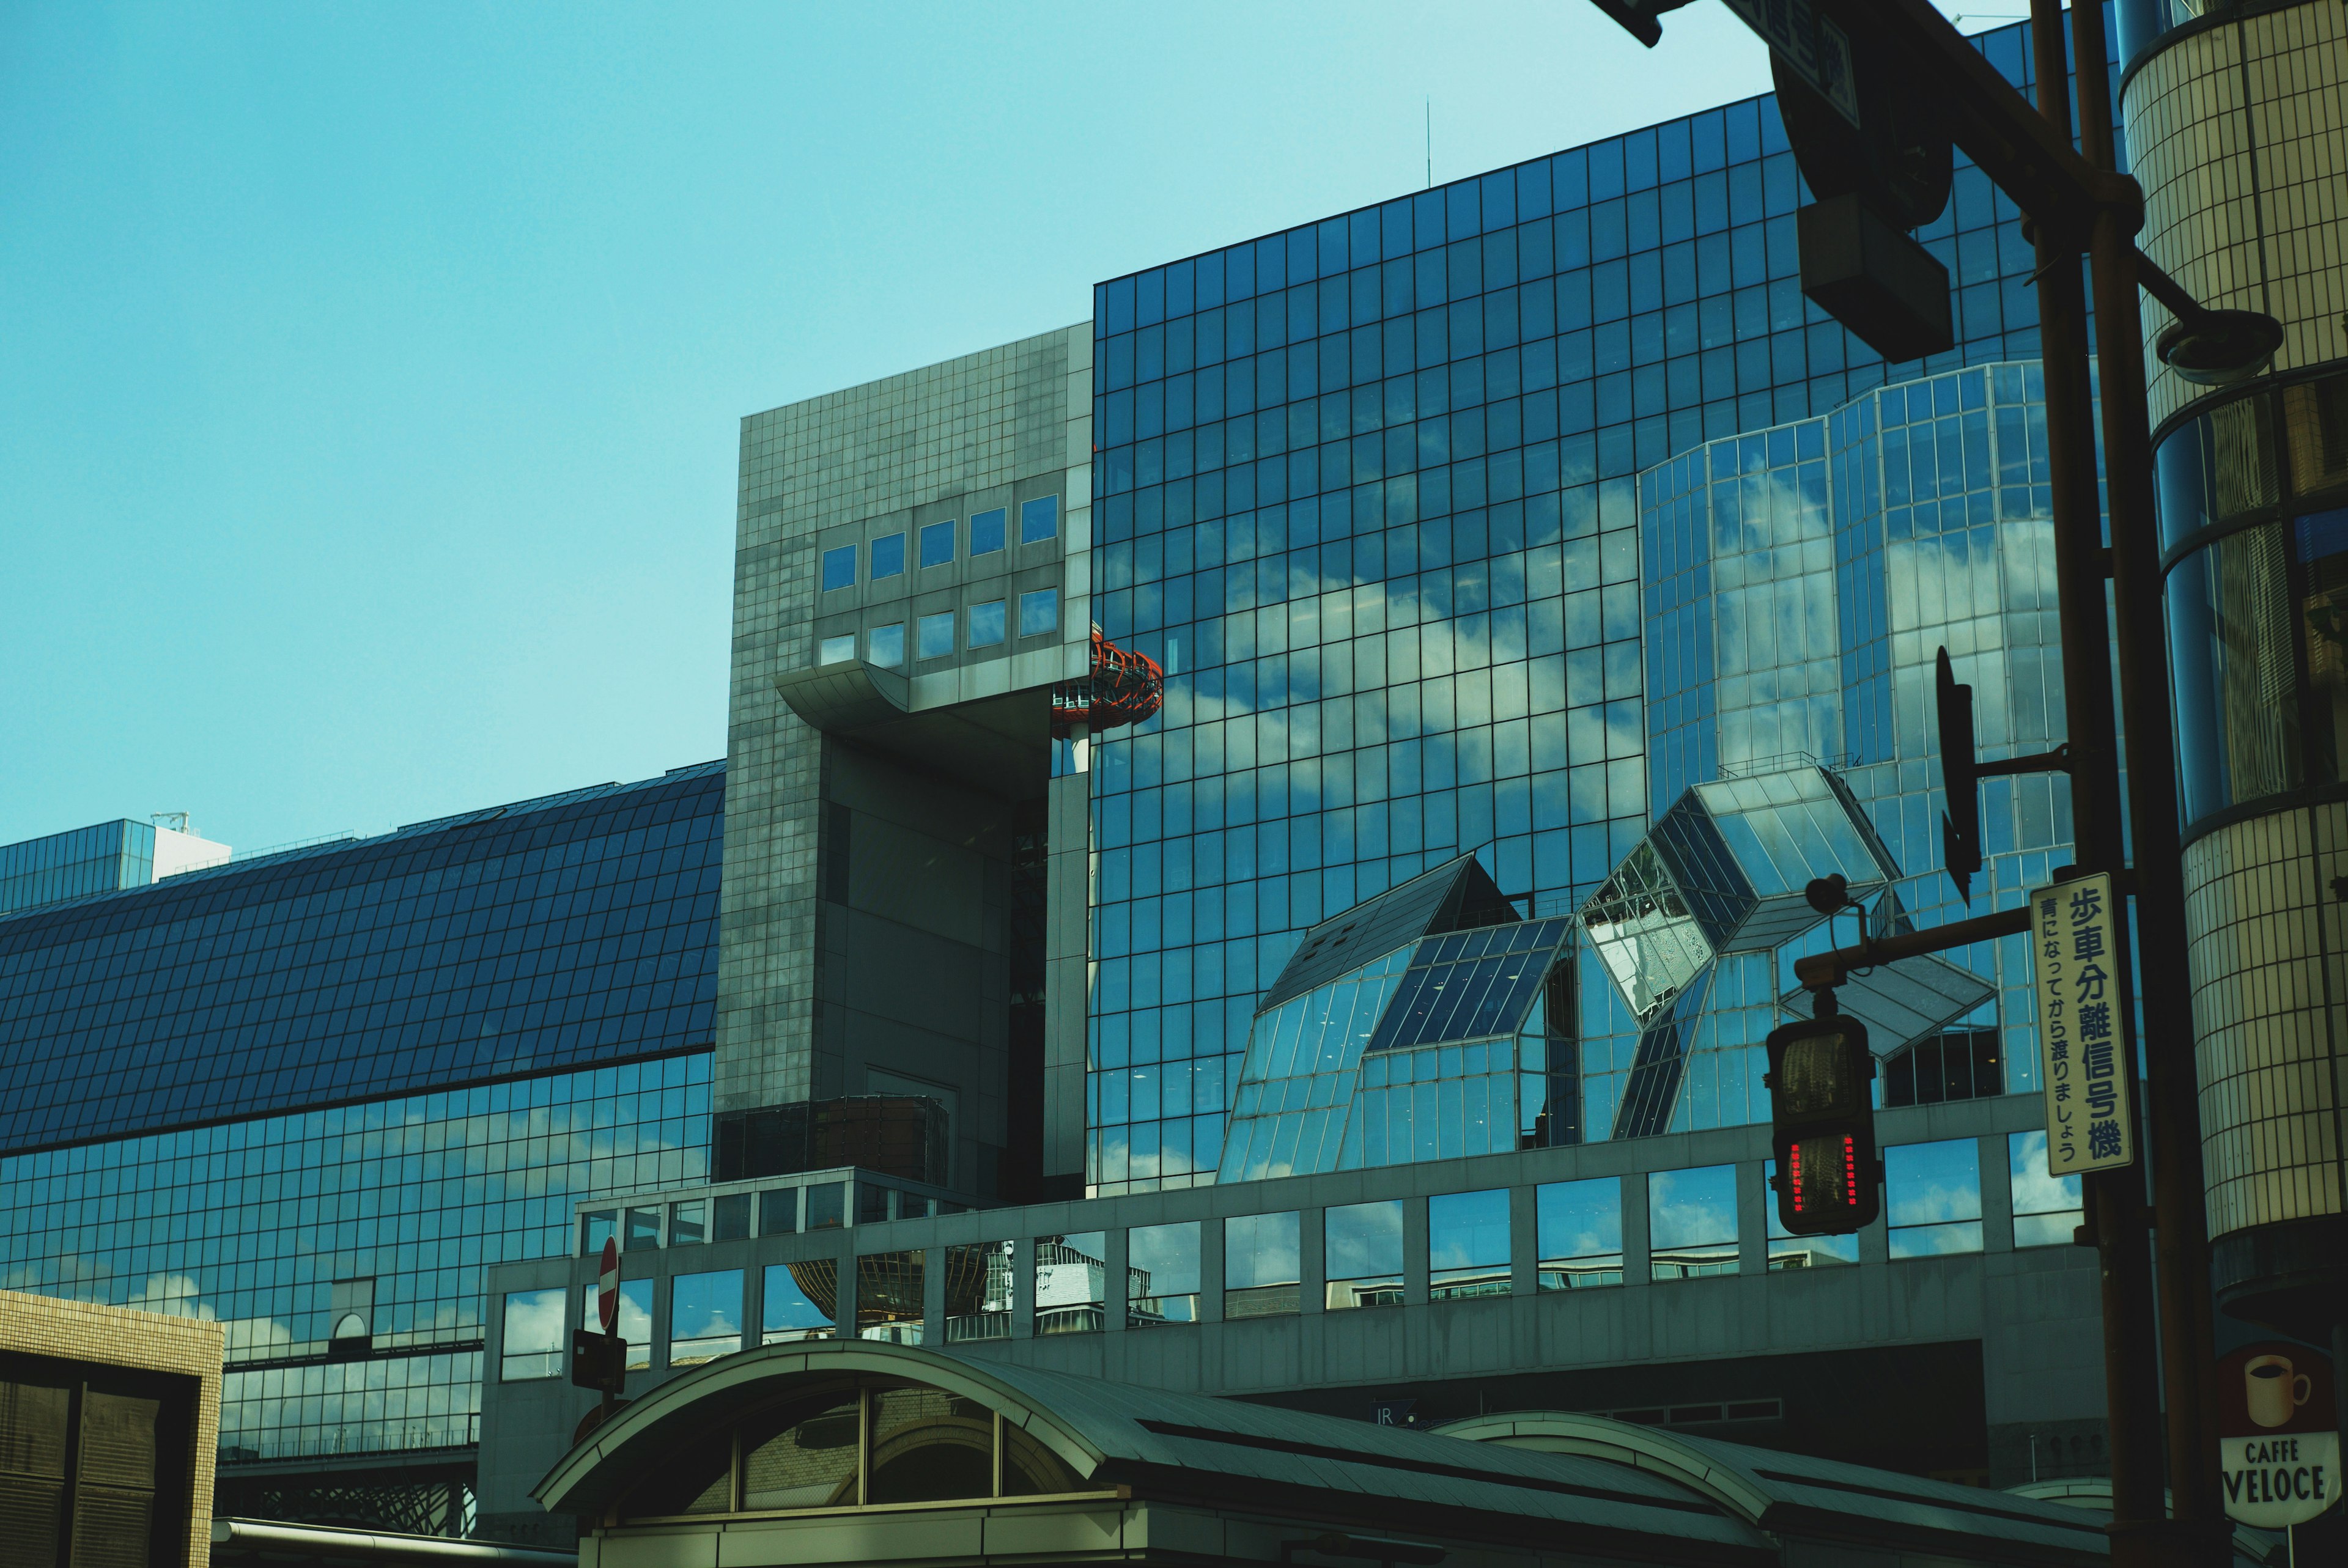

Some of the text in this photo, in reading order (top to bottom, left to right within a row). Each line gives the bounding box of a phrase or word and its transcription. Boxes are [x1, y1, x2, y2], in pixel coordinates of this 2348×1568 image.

[2039, 897, 2075, 1163] 青になってから渡りましょう
[2069, 888, 2122, 1160] 歩車分離信号機
[2223, 1466, 2325, 1504] VELOCE
[2246, 1438, 2298, 1463] CAFFÈ
